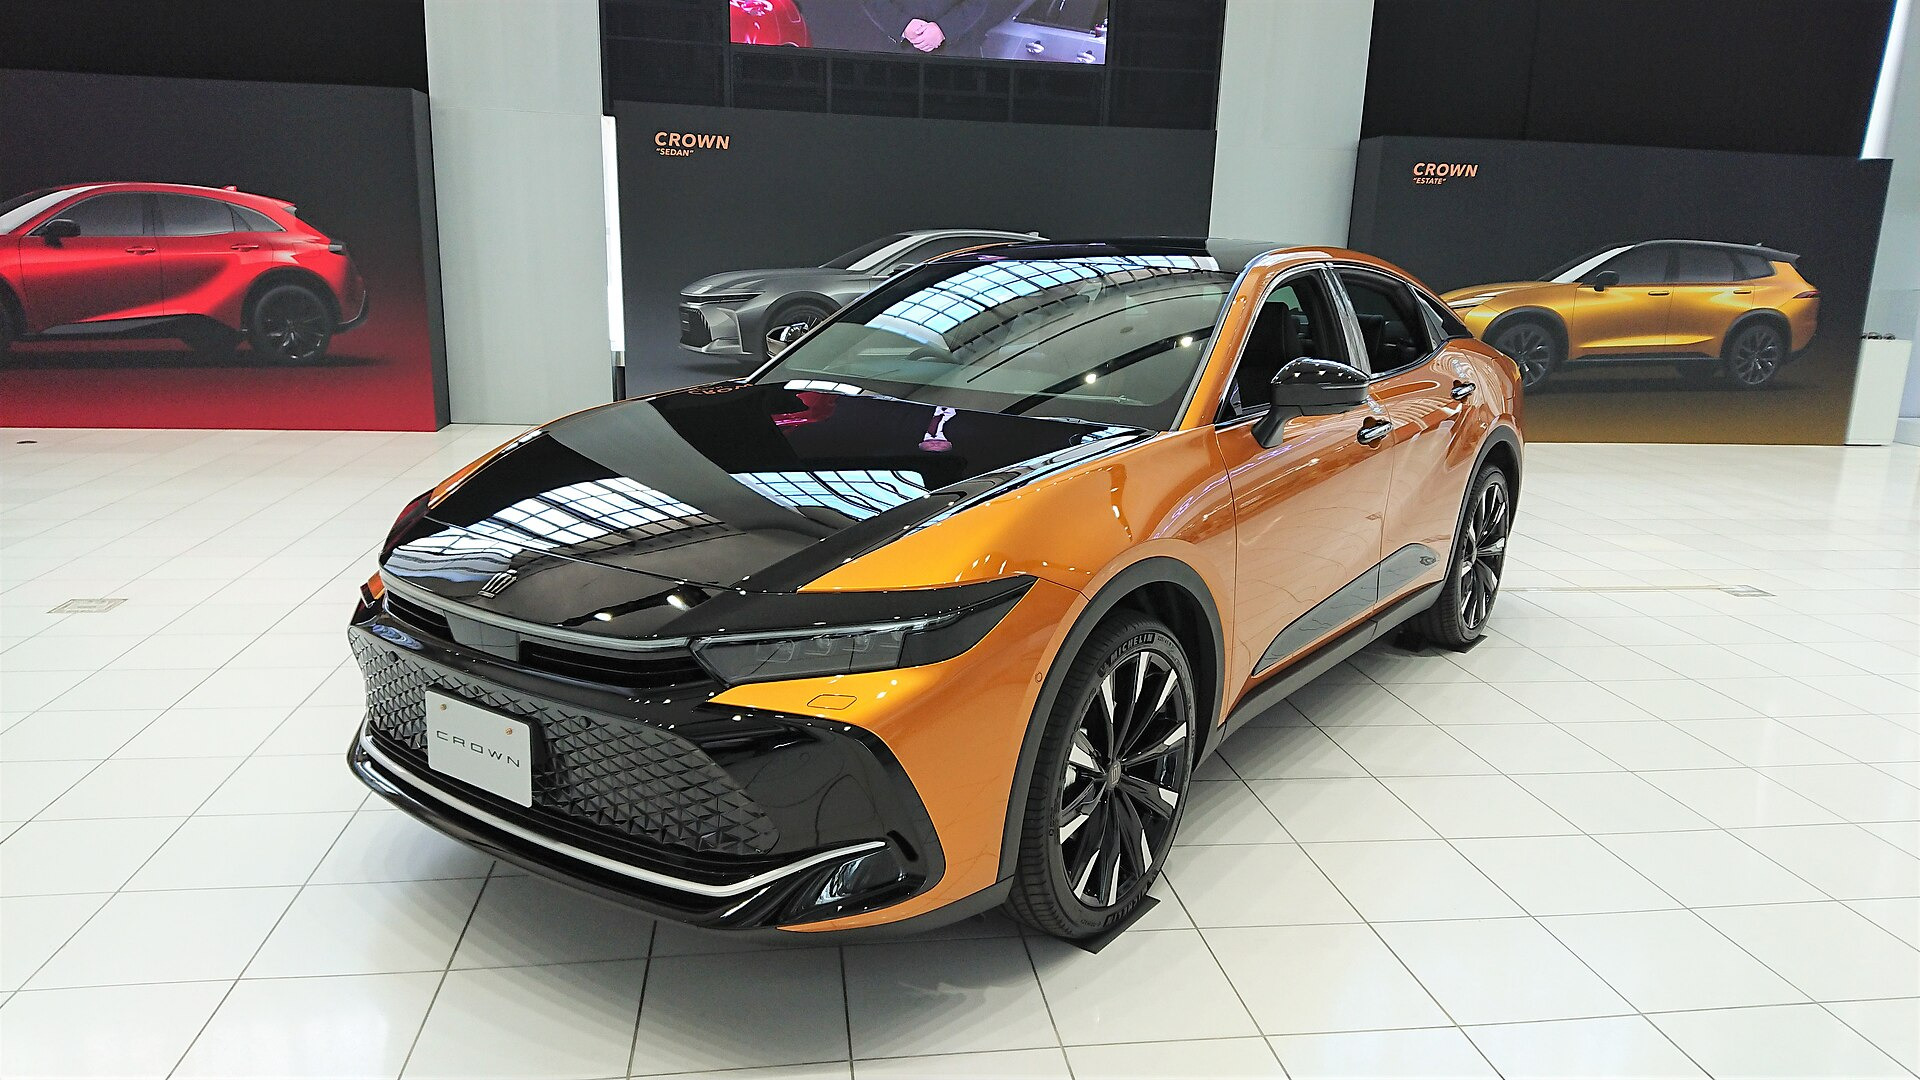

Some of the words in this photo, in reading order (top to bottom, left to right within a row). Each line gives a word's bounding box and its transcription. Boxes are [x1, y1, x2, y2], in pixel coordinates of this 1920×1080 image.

[654, 131, 730, 150] CROWN
[1413, 162, 1479, 178] CROWN
[1110, 633, 1154, 663] MICHELIN
[436, 730, 520, 768] CROWN
